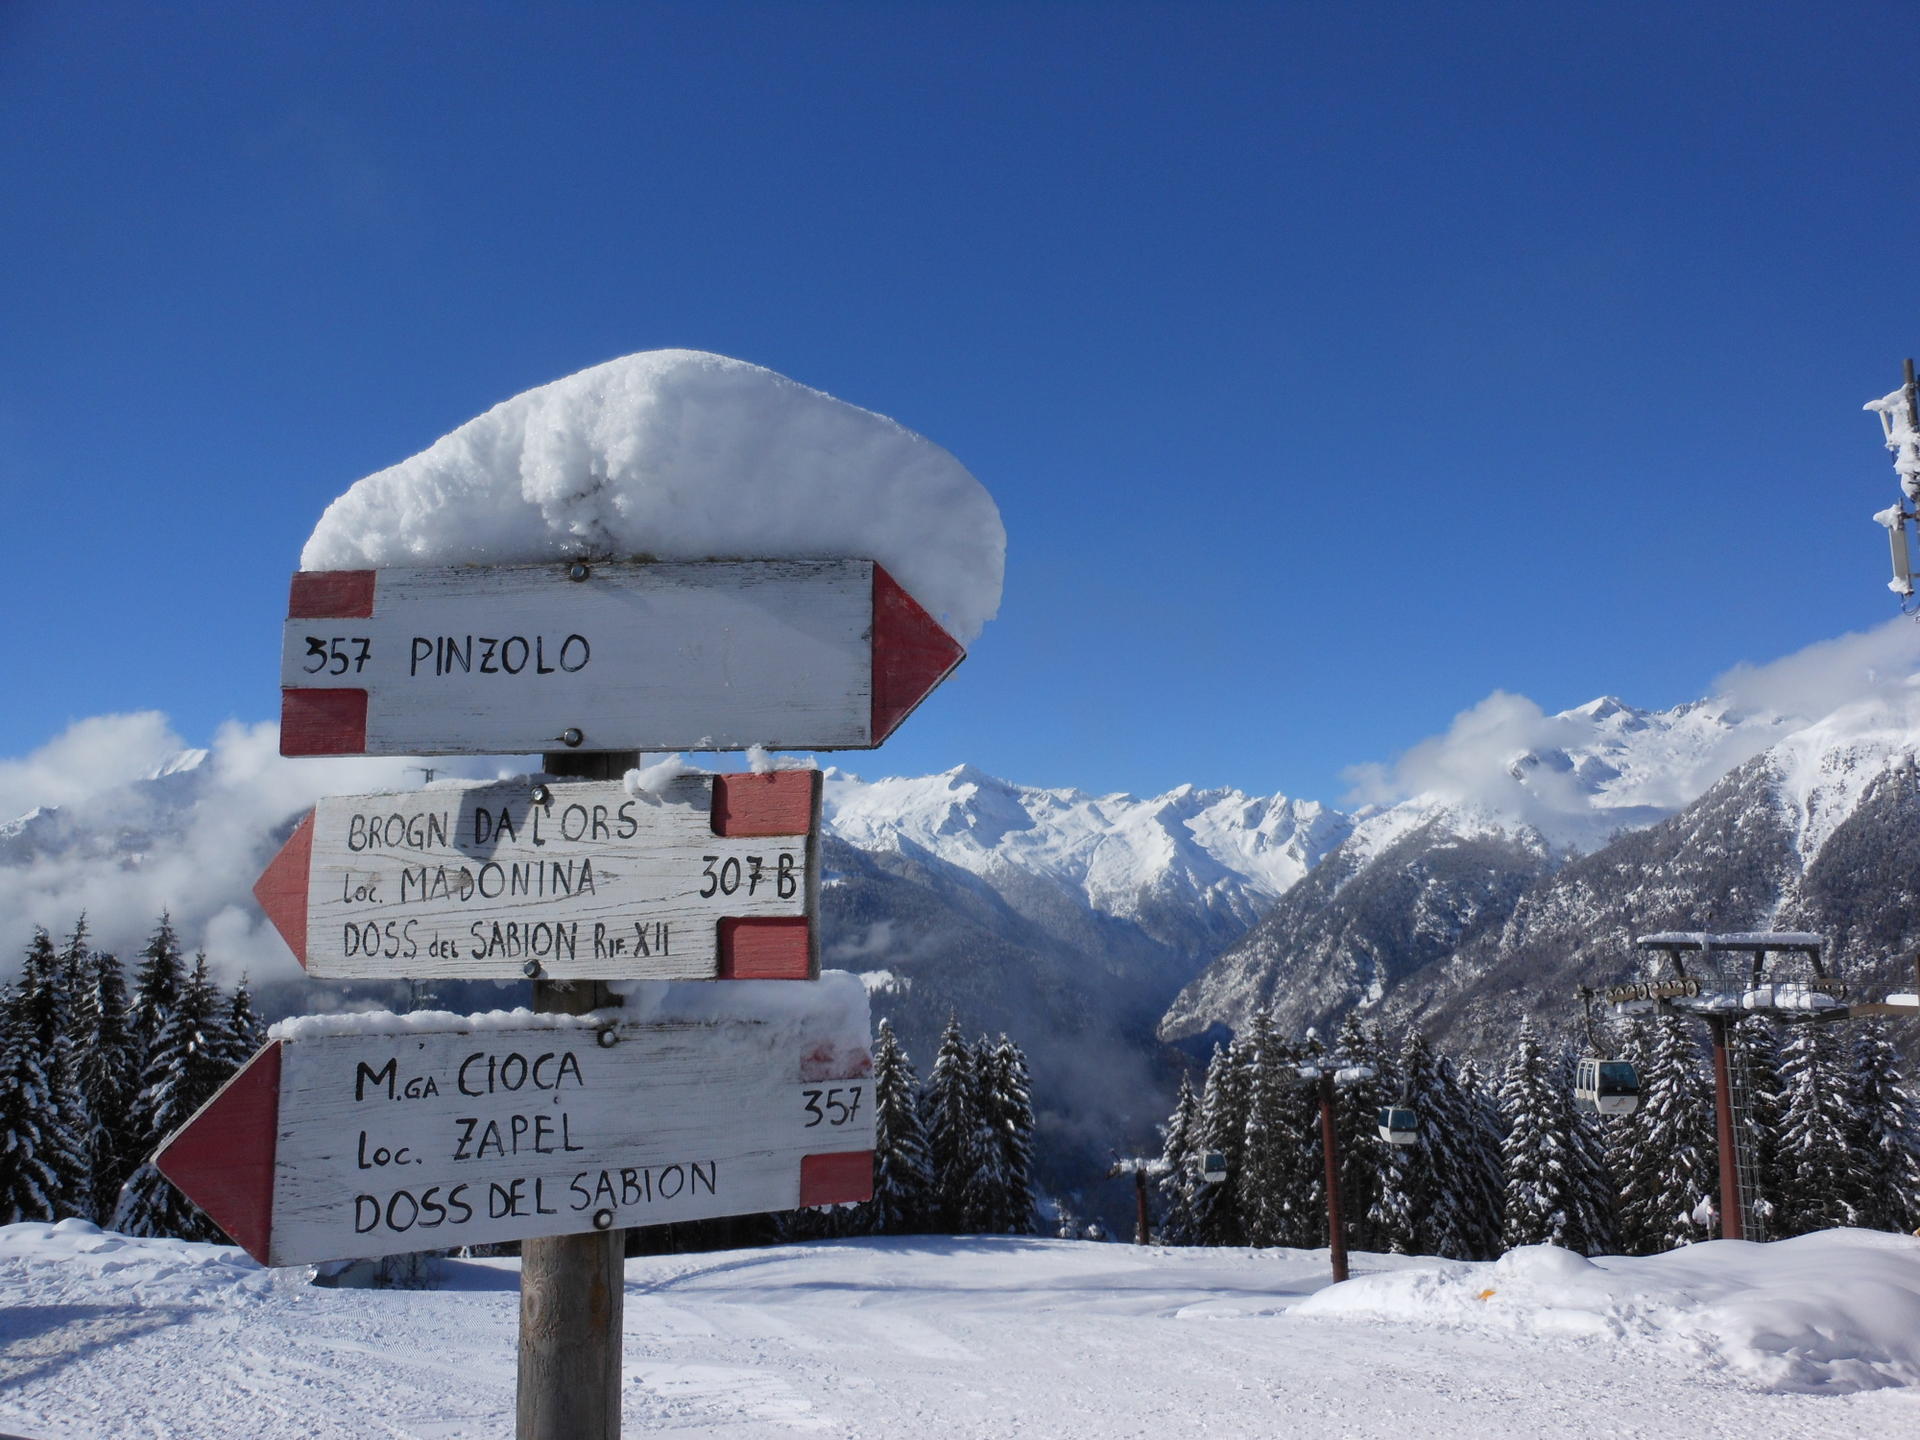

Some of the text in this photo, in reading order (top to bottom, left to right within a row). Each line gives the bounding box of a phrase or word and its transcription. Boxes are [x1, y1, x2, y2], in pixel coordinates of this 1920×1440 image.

[303, 634, 590, 676] 357 PINZOLO
[348, 811, 448, 851] BROGN
[474, 806, 516, 845] DA
[400, 858, 596, 904] MADONINA
[344, 919, 419, 960] DOSS
[470, 920, 578, 961] SABION
[633, 921, 669, 957] XII
[458, 1051, 584, 1097] CIOCA
[802, 1086, 861, 1128] 357
[453, 1112, 584, 1161] ZAPEL
[354, 1161, 716, 1234] DOSS DEL SABION
